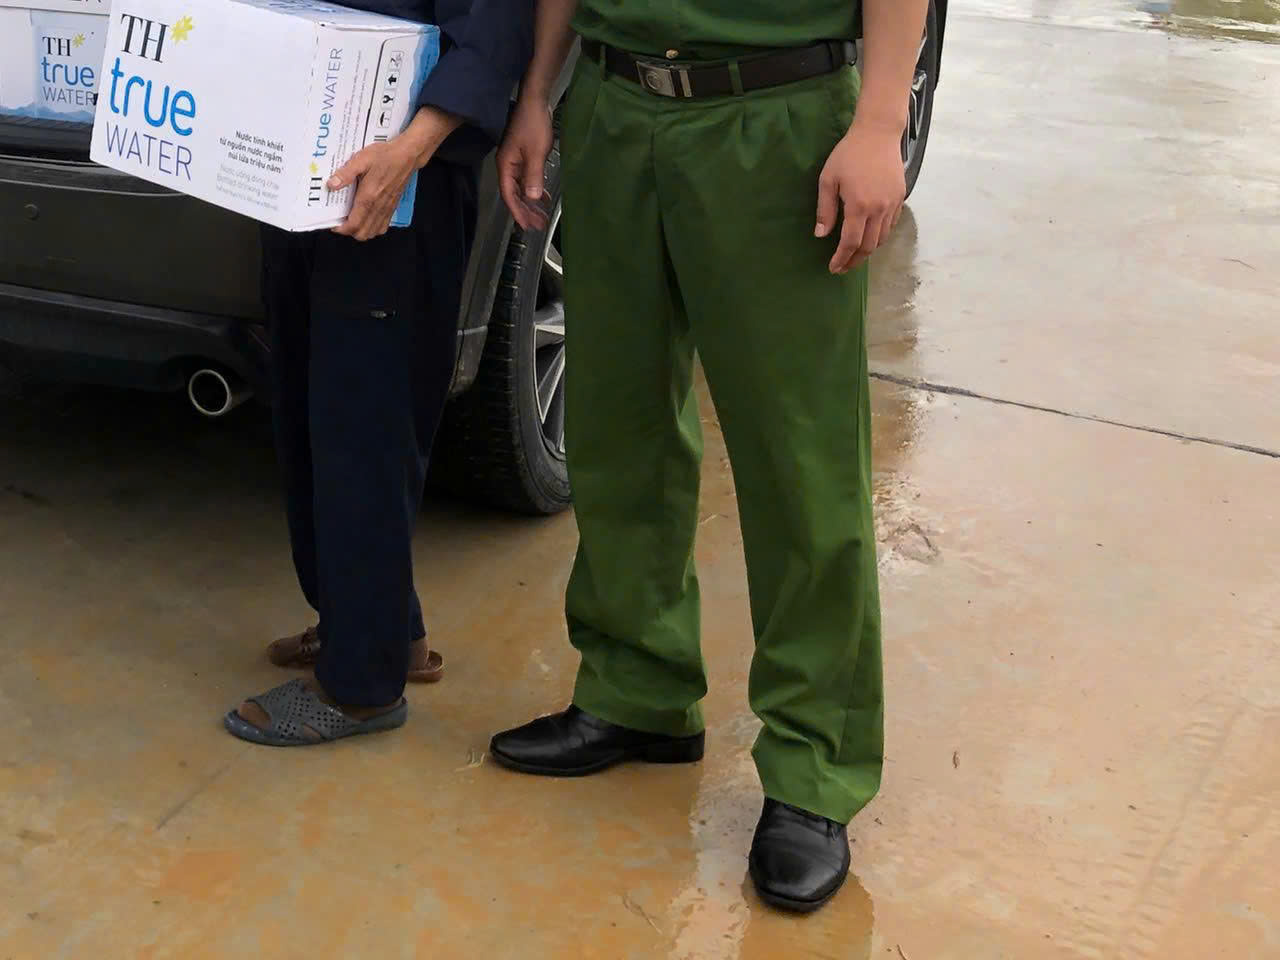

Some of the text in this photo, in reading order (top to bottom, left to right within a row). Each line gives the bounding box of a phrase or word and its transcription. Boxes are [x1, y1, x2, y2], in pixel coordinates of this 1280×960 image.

[42, 36, 72, 57] TH
[120, 14, 169, 63] TH
[41, 56, 94, 88] true
[322, 48, 343, 111] WATER
[42, 87, 95, 106] WATER
[110, 57, 196, 137] true
[106, 121, 191, 181] WATER
[312, 113, 331, 158] true
[308, 176, 322, 207] TH
